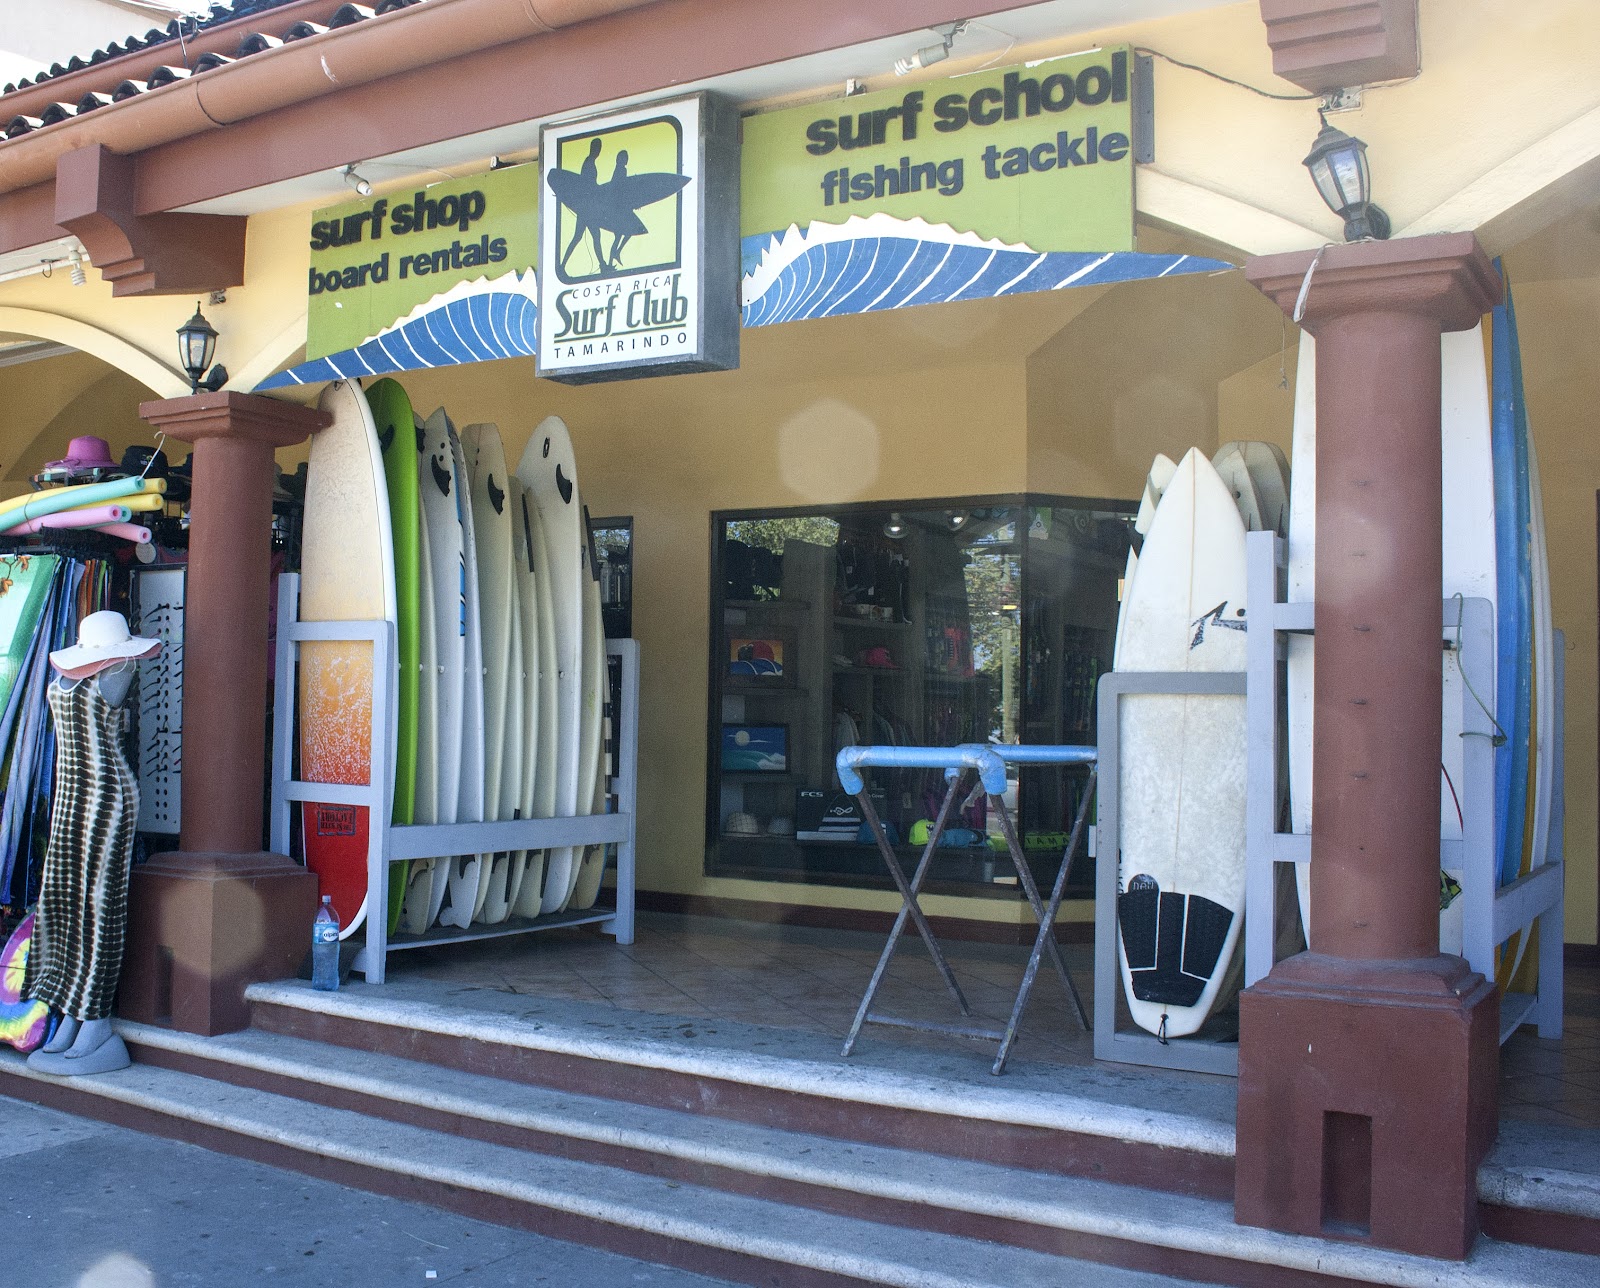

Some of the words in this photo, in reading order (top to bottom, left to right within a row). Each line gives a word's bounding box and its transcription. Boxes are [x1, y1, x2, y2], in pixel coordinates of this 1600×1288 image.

[805, 91, 924, 156] surf
[933, 50, 1128, 133] school
[820, 156, 964, 206] fishing
[981, 126, 1129, 180] tackle
[310, 199, 388, 250] surf
[390, 190, 486, 236] shop
[309, 252, 390, 296] board
[399, 234, 508, 280] rentals
[572, 282, 622, 300] COSTA
[633, 275, 672, 291] RICA
[554, 288, 619, 338] Surf
[626, 273, 689, 329] Club
[554, 332, 687, 359] TAMARINDO
